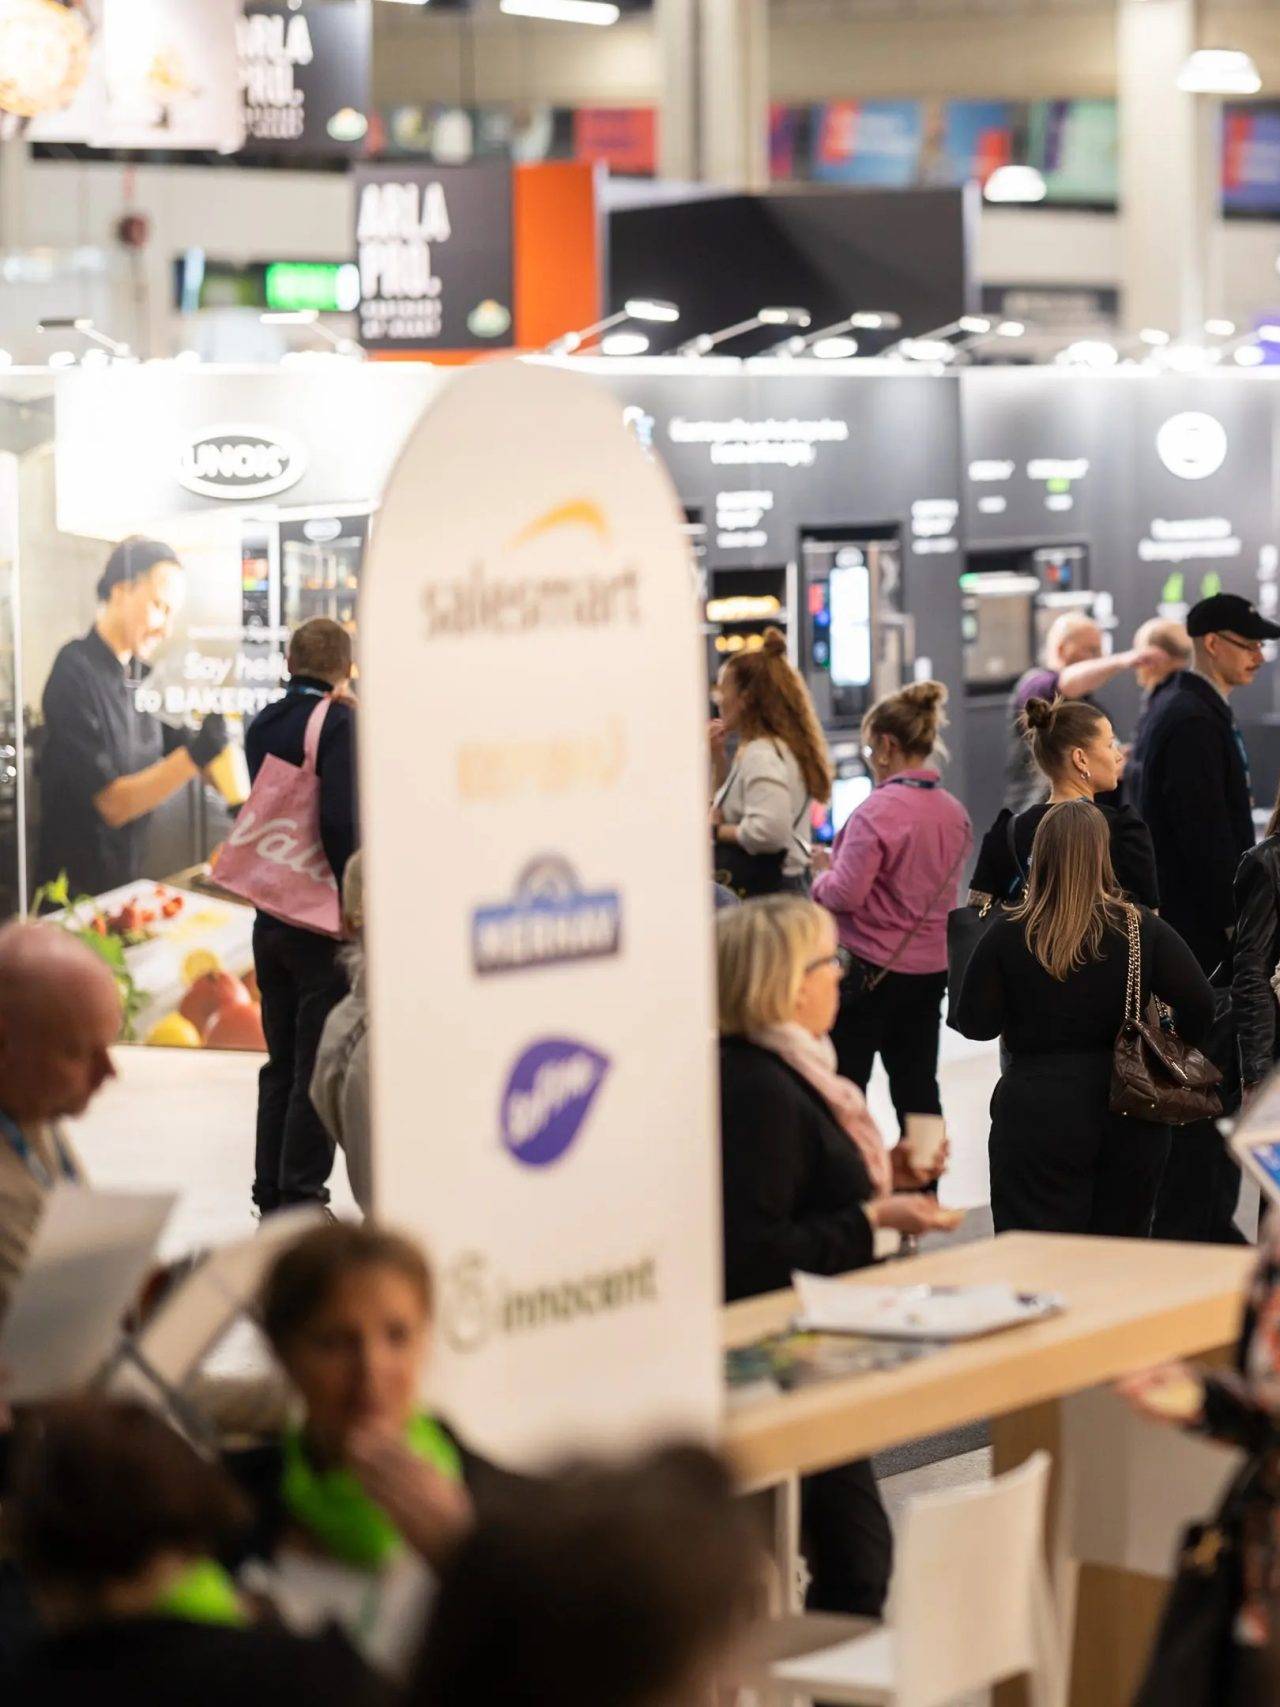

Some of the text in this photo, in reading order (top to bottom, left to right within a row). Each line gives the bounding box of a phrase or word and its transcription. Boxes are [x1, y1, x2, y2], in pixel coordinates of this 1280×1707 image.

[357, 182, 451, 242] ARLA
[184, 651, 233, 685] Say
[503, 1256, 656, 1332] innocent
